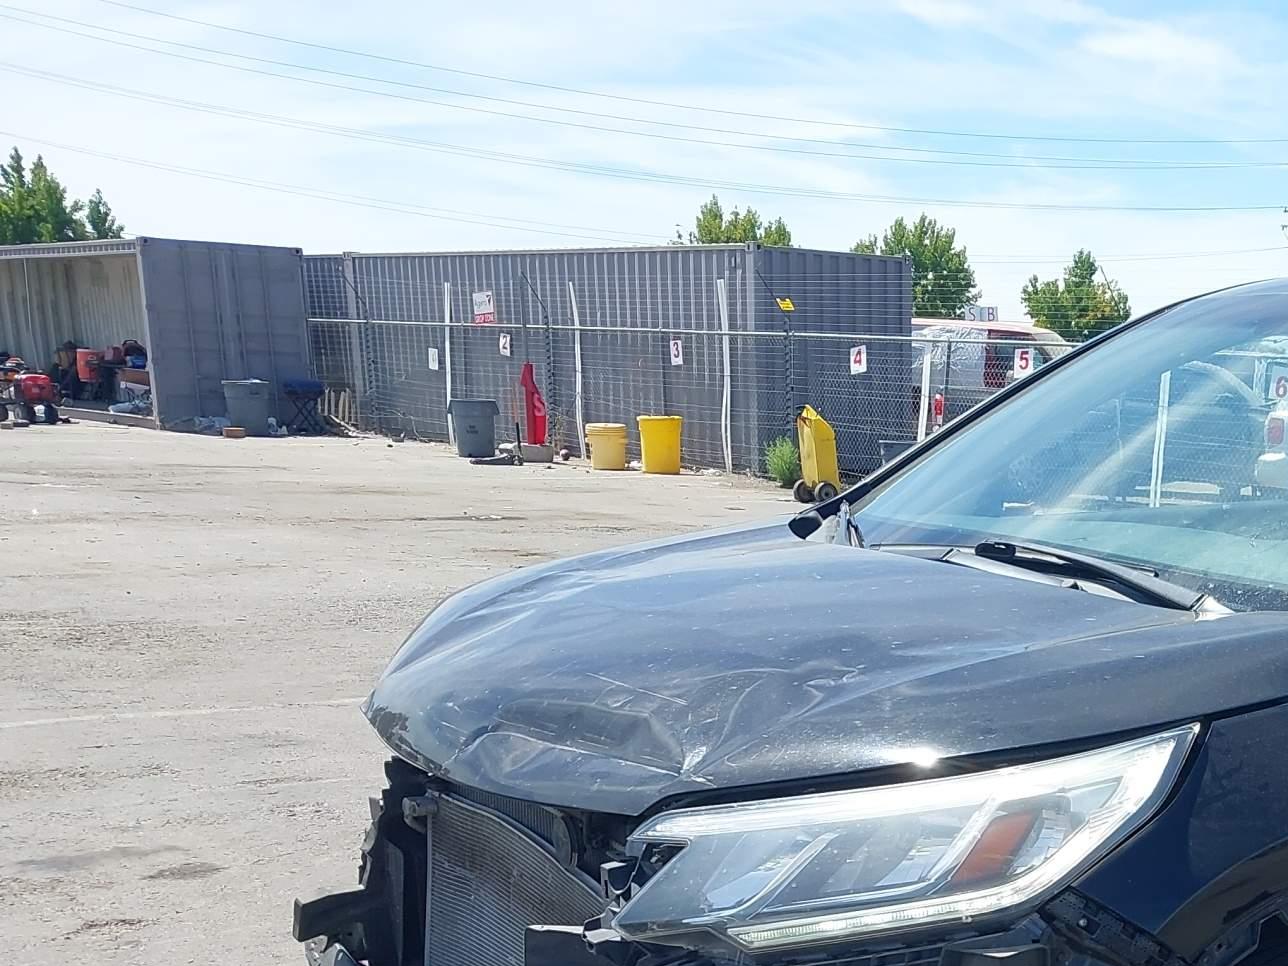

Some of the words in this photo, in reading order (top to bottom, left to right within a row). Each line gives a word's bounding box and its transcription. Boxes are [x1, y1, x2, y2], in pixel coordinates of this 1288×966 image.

[673, 341, 680, 358] 3
[854, 348, 862, 366] 4
[1019, 350, 1029, 370] 5
[1275, 375, 1288, 398] 6
